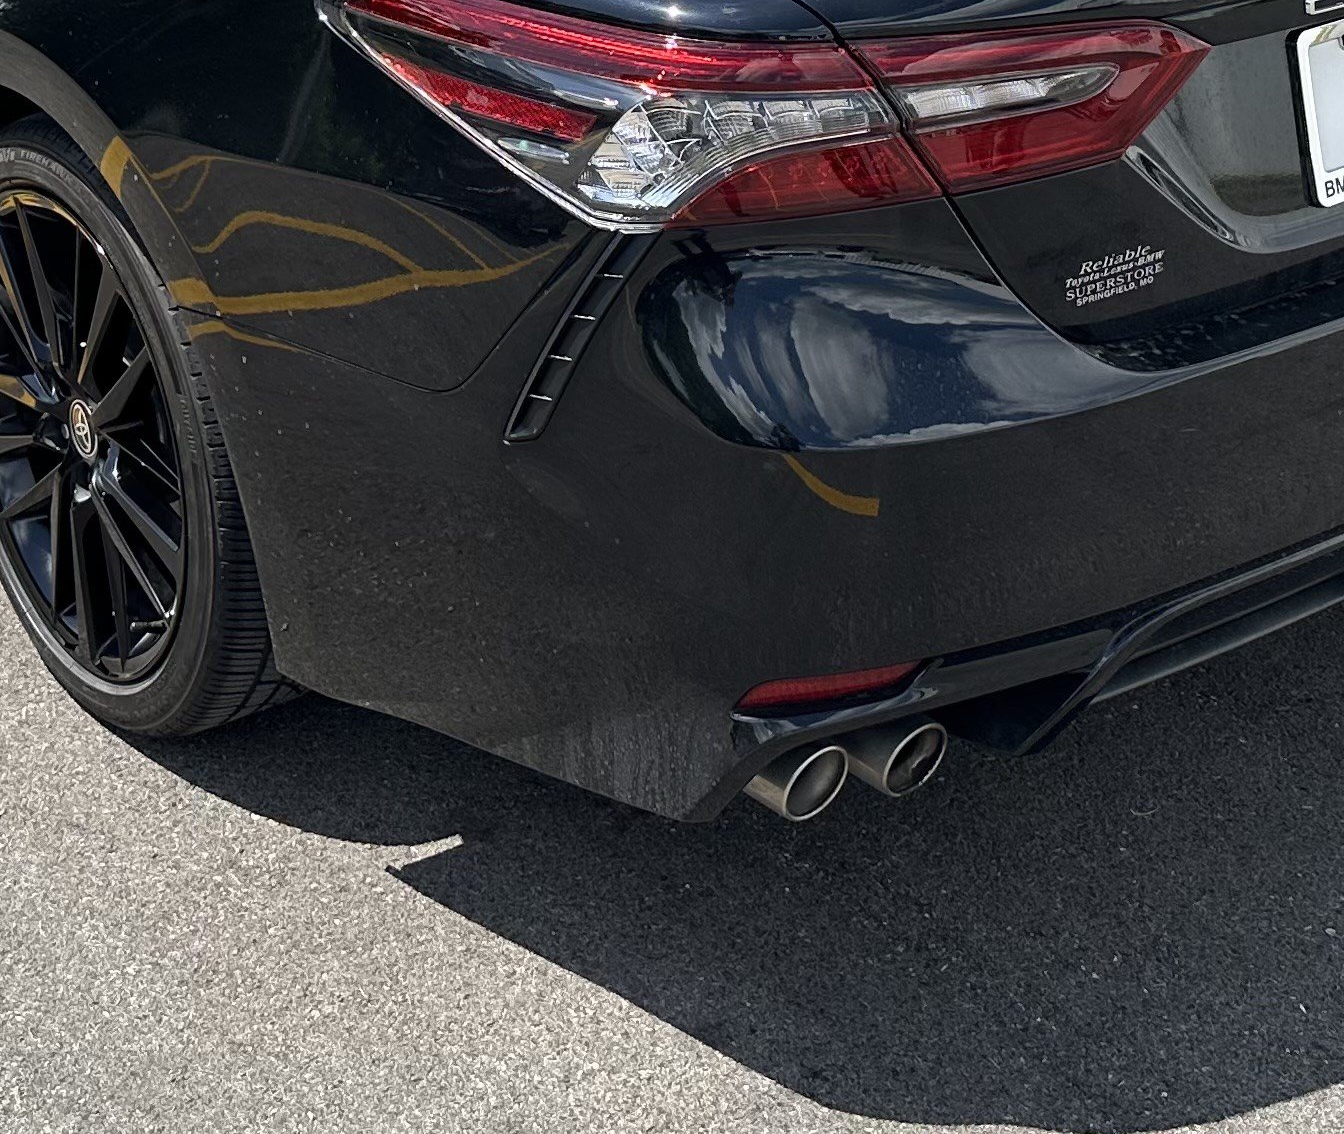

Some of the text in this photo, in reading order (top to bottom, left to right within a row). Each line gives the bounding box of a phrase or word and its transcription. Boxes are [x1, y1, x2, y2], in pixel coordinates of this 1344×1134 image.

[1079, 245, 1151, 275] Reliable
[1065, 262, 1164, 301] SUPERSTORE
[1076, 276, 1154, 307] SPRINGFIELD, MO
